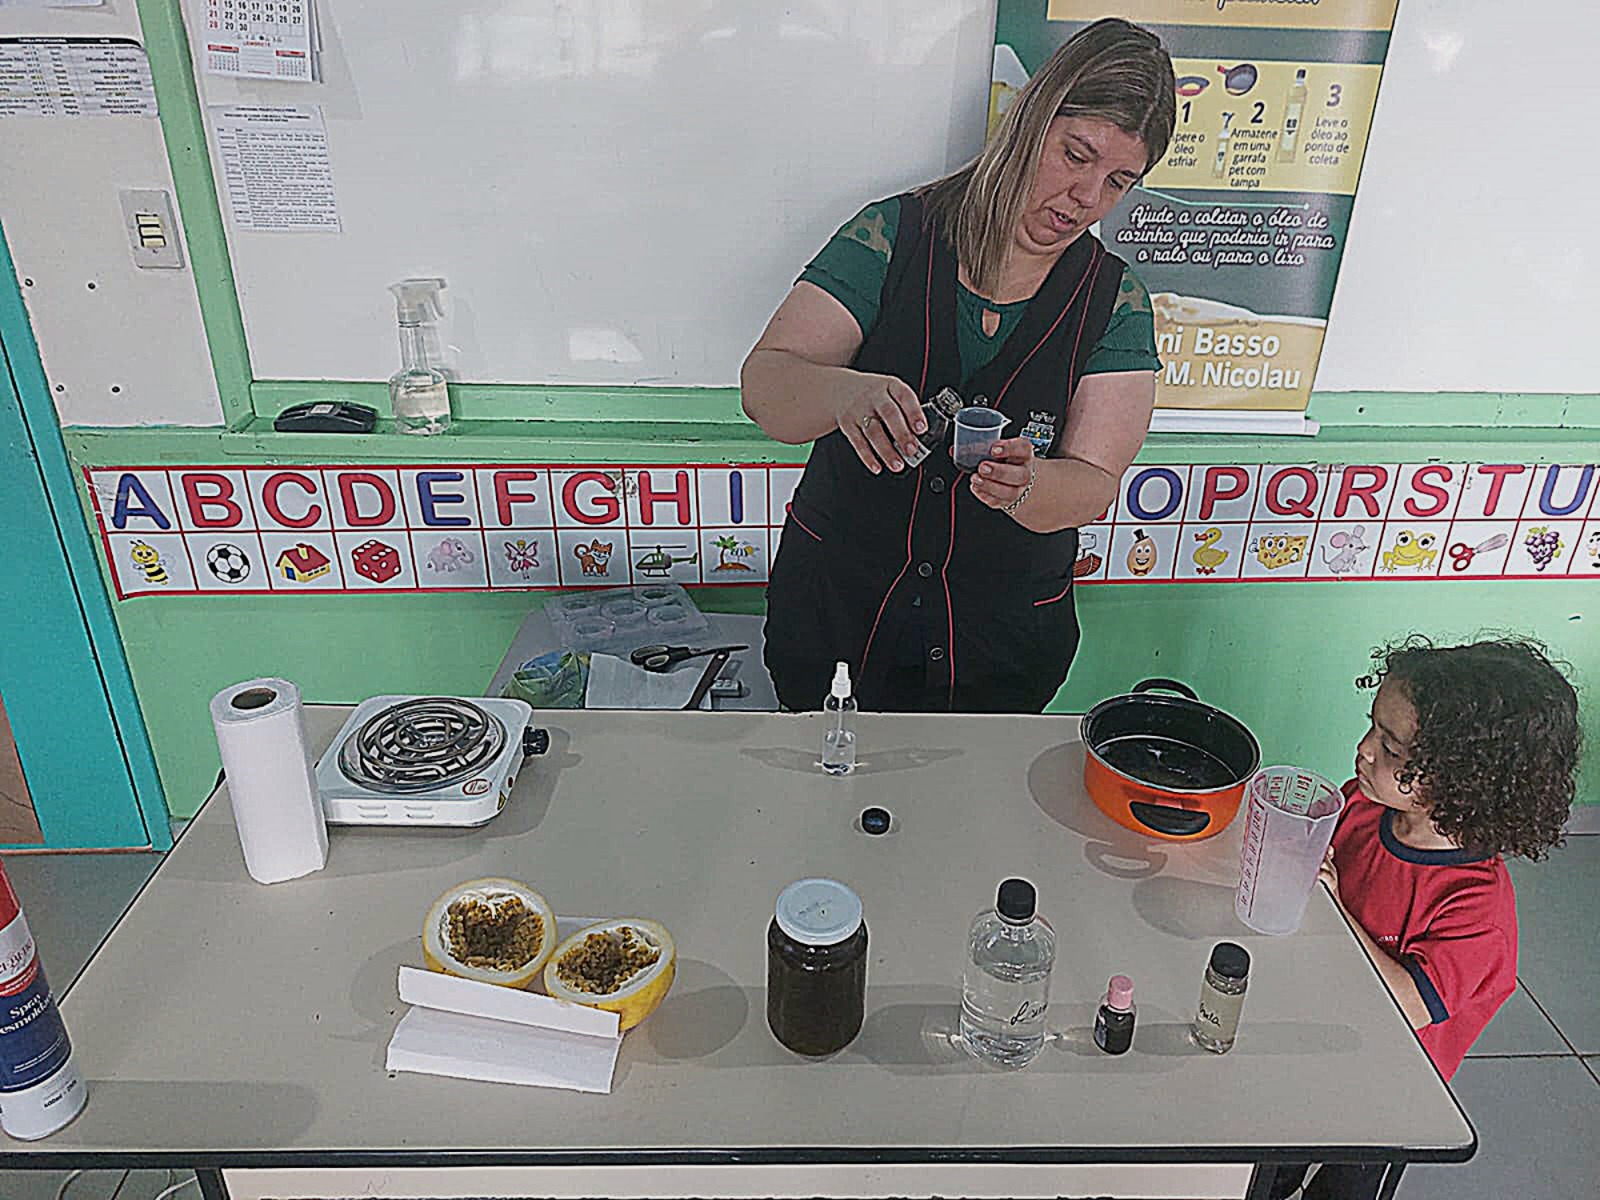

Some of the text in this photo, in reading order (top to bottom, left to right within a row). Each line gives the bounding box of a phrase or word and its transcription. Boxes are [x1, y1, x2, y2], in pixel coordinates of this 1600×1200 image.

[224, 0, 233, 9] 15
[238, 2, 247, 10] 16
[251, 2, 260, 10] 17
[265, 3, 274, 12] 18
[279, 4, 288, 12] 19
[292, 5, 301, 13] 20
[224, 11, 233, 20] 22
[238, 13, 247, 21] 23
[252, 14, 261, 22] 24
[265, 14, 274, 22] 25
[279, 15, 288, 24] 26
[292, 16, 301, 25] 27
[225, 22, 234, 31] 29
[239, 23, 248, 31] 30
[1326, 84, 1342, 107] 3
[1182, 101, 1191, 123] 1
[1251, 102, 1265, 123] 2
[1316, 117, 1348, 127] Leve o
[1199, 133, 1205, 142] o
[1231, 129, 1278, 138] Armazene
[1311, 128, 1348, 140] óleo ao
[1175, 142, 1194, 154] óleo
[1233, 142, 1271, 151] em uma
[1304, 142, 1349, 153] ponto de
[1168, 156, 1198, 167] esfriar
[1232, 152, 1266, 165] garrafa
[1309, 153, 1339, 165] coleta
[1229, 166, 1266, 176] pet com
[1230, 177, 1260, 189] tampa
[1131, 205, 1328, 229] Ajude a coletar o óleo de
[1117, 226, 1335, 250] cozinha que poderia ir para
[1136, 246, 1305, 269] o ralo ou para o lixo
[1194, 327, 1281, 357] Basso
[1165, 361, 1301, 390] M. Nicolau
[112, 463, 1595, 530] A B C D E F G H I O P Q R S T U
